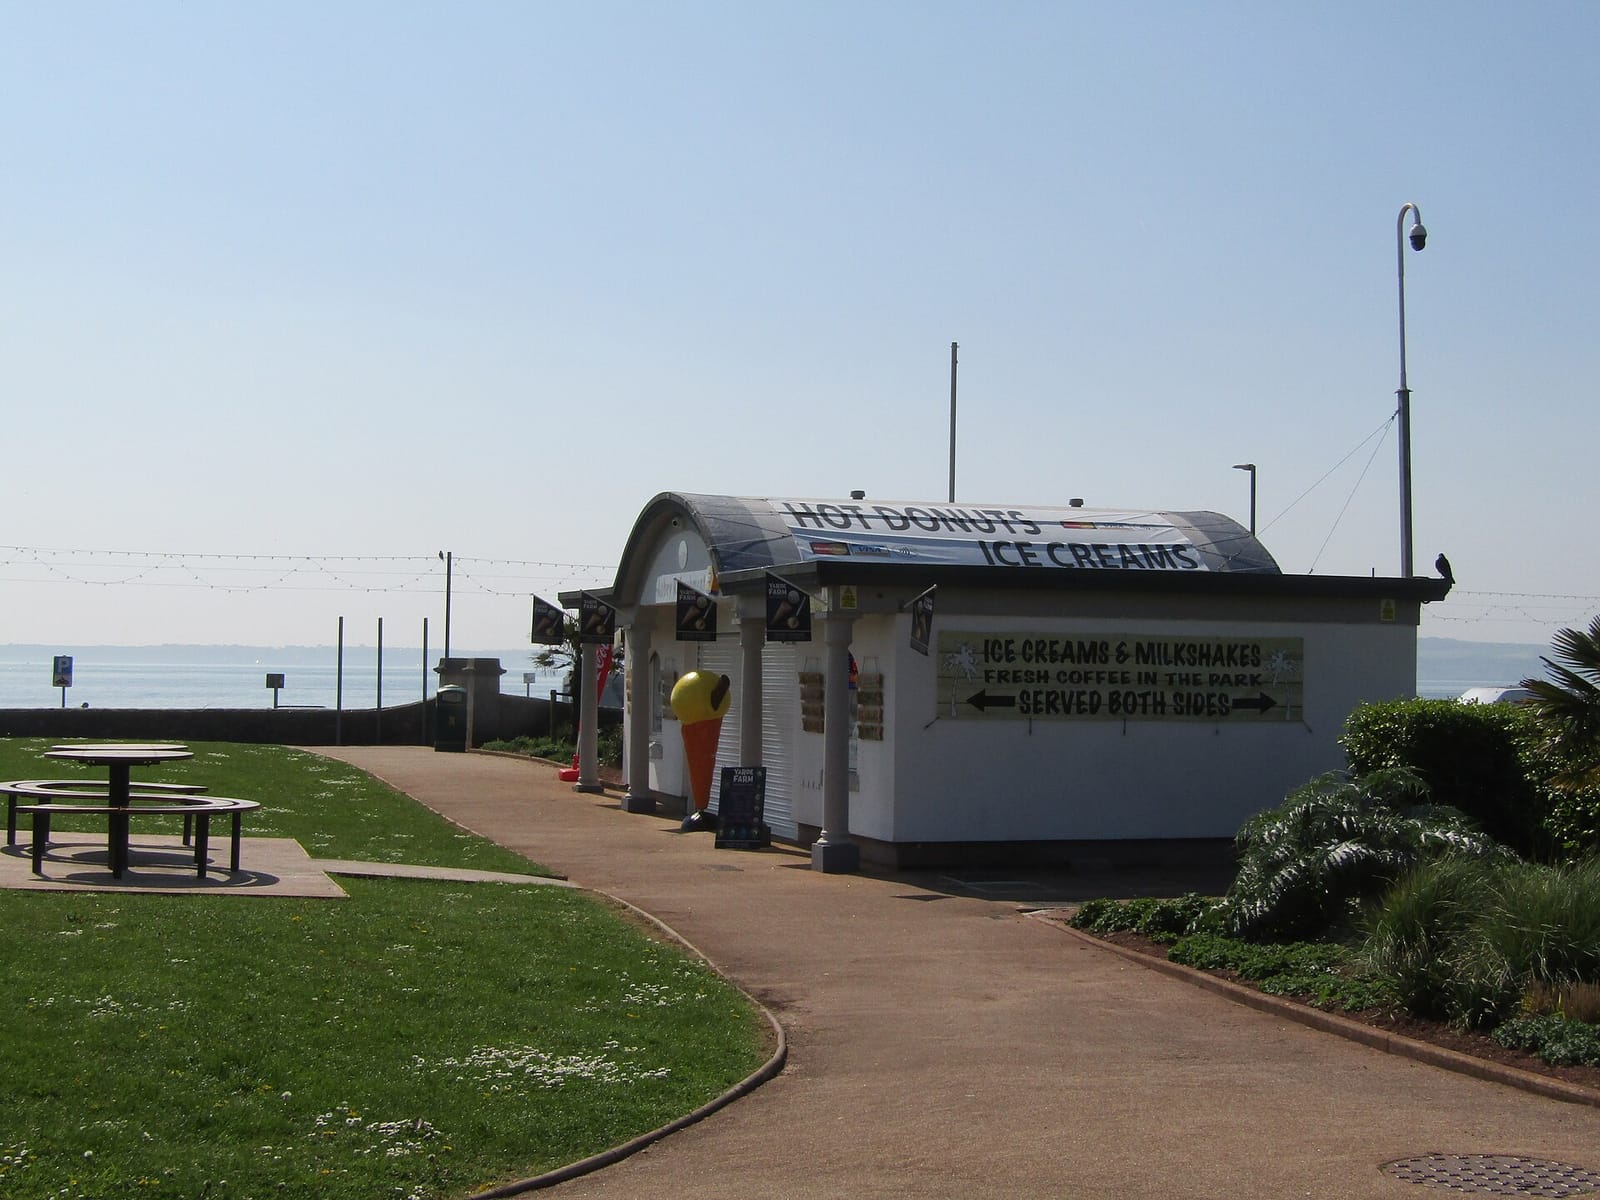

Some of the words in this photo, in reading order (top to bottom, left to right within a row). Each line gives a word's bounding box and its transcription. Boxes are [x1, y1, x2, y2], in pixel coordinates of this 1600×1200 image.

[782, 502, 872, 530] HOT
[873, 506, 1041, 535] DONUTS
[978, 540, 1042, 567] ICE
[1046, 541, 1198, 570] CREAMS
[983, 639, 1016, 664] ICE
[1021, 640, 1109, 665] CREAMS
[1115, 641, 1129, 664] &
[1135, 642, 1261, 668] MILKSHAKES
[984, 670, 1050, 684] FRESH
[1055, 671, 1131, 685] COFFEE
[1137, 672, 1157, 685] IN
[1164, 673, 1203, 686] THE
[1208, 674, 1262, 687] PARK
[1018, 690, 1103, 715] SERVED
[1108, 691, 1166, 716] BOTH
[1172, 692, 1231, 717] SIDES
